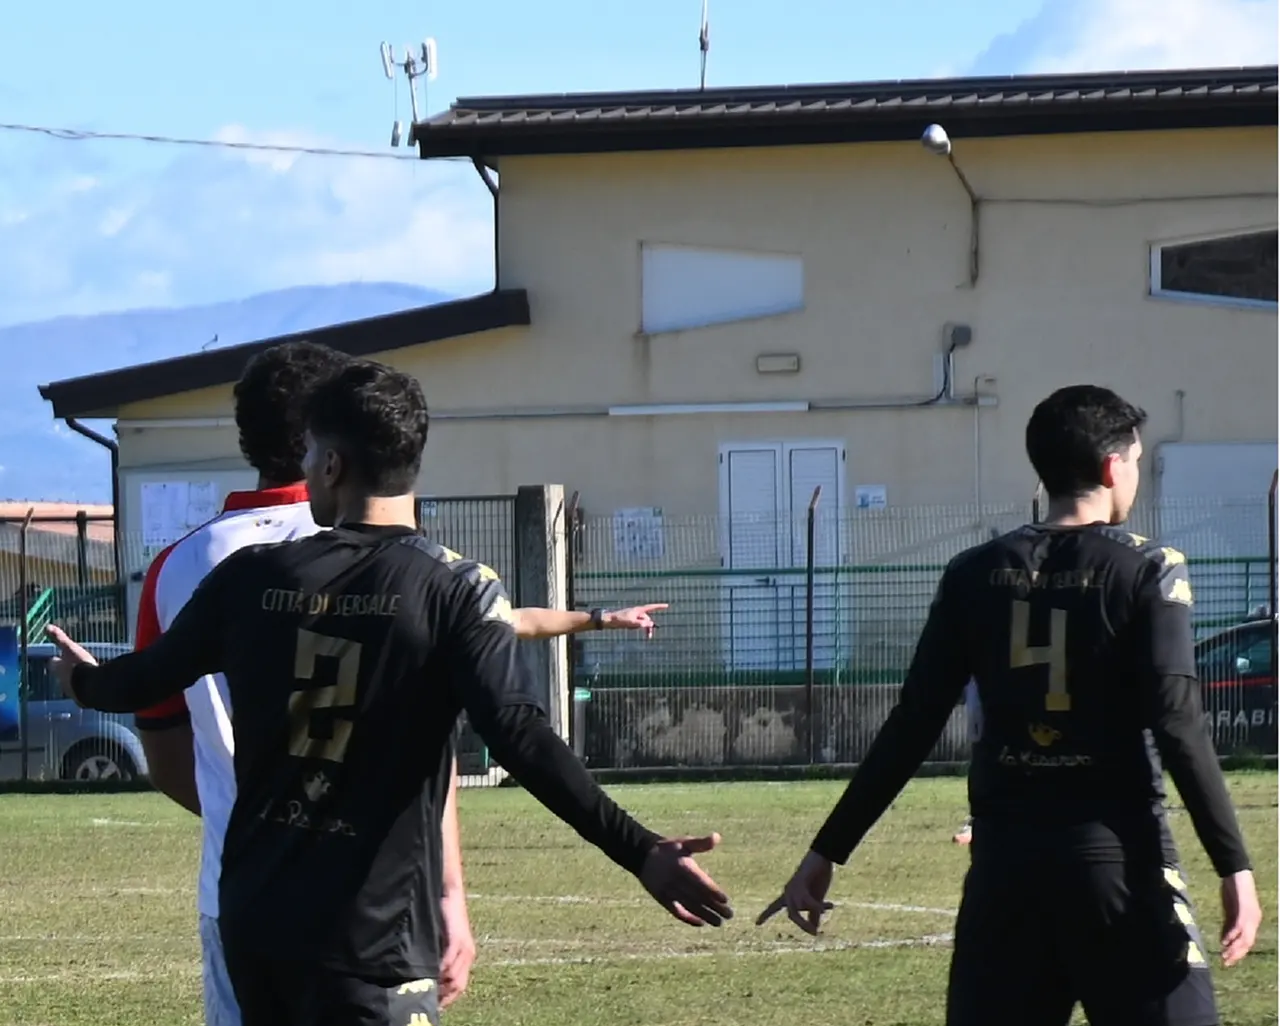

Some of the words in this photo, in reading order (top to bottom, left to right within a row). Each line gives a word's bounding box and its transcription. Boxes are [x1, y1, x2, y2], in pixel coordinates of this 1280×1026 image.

[307, 593, 330, 616] DI
[331, 593, 402, 617] SERSALE
[1010, 599, 1071, 712] 4
[288, 627, 363, 763] 2
[1203, 709, 1273, 728] ARABI
